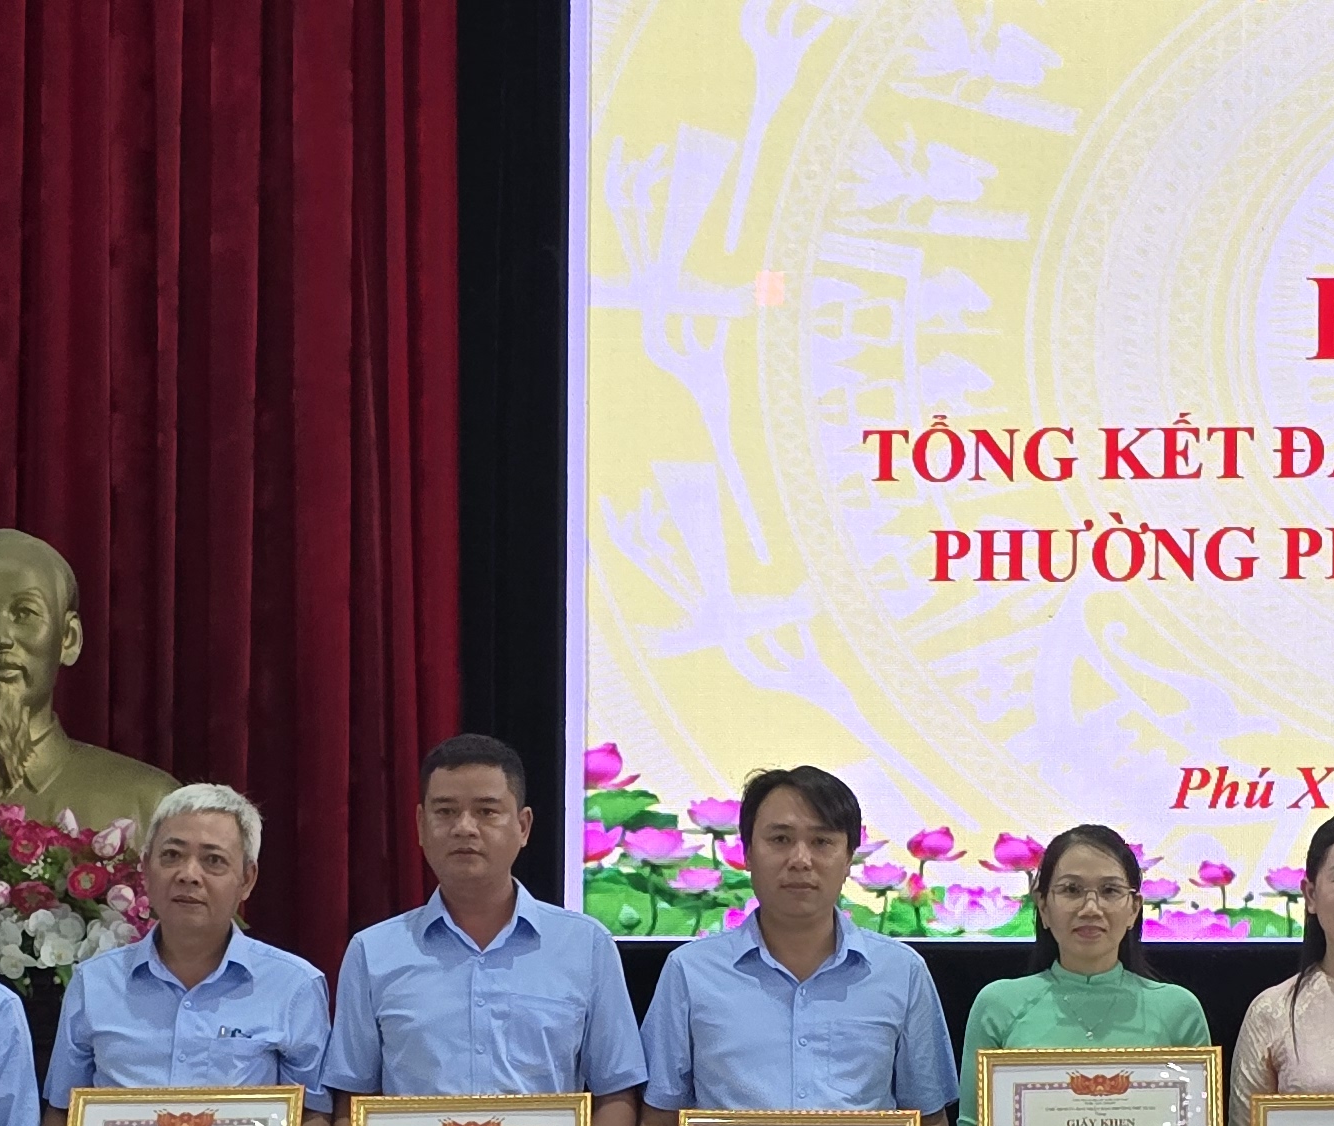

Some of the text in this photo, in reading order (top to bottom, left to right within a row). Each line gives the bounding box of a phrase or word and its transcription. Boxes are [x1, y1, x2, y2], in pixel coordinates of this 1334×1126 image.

[862, 415, 1079, 483] TỔNG
[1099, 413, 1255, 480] KẾT
[929, 512, 1259, 583] PHƯỜNG
[1169, 765, 1275, 810] Phú
